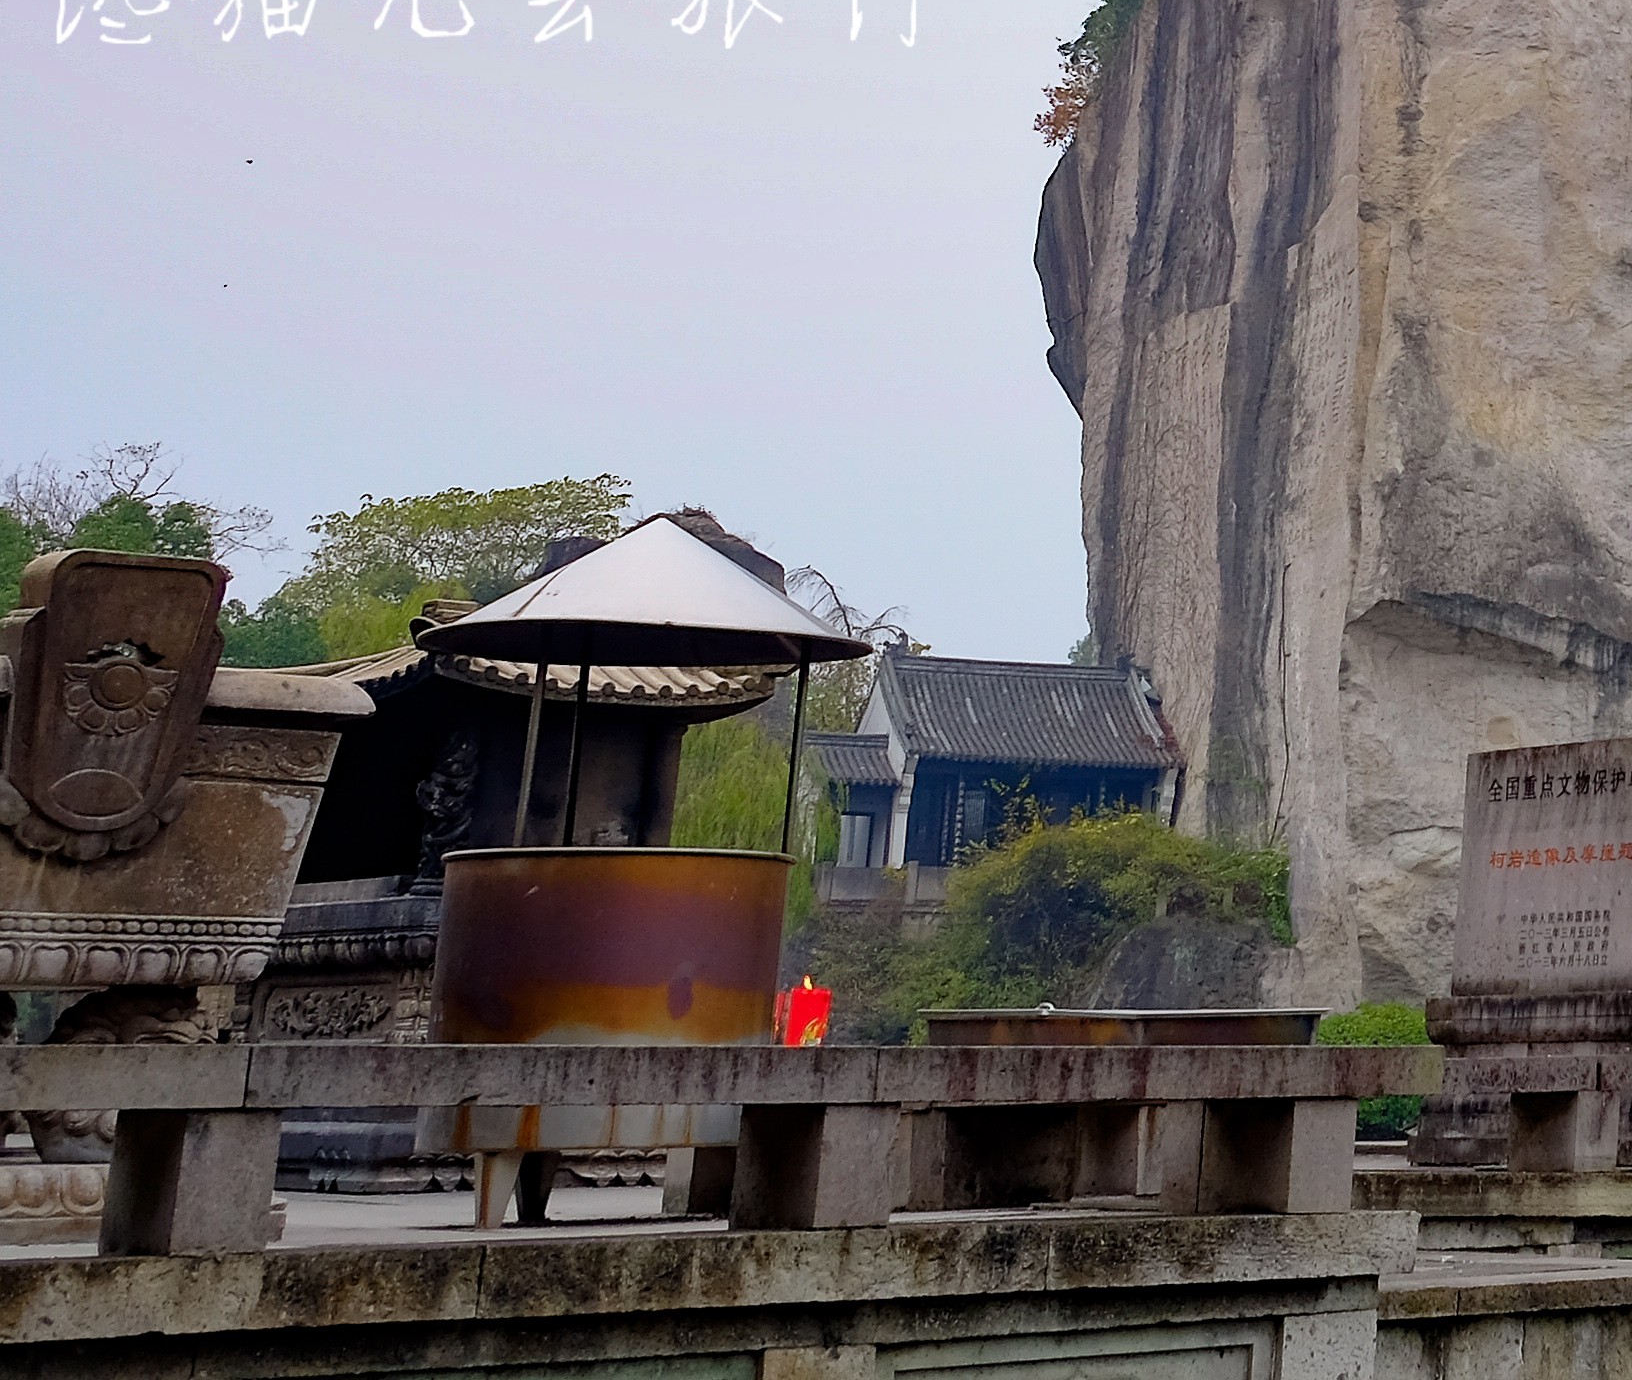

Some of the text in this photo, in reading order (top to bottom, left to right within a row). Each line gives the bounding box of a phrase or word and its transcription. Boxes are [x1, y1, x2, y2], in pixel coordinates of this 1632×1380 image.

[1520, 910, 1611, 925] 中华人民共和国国务院
